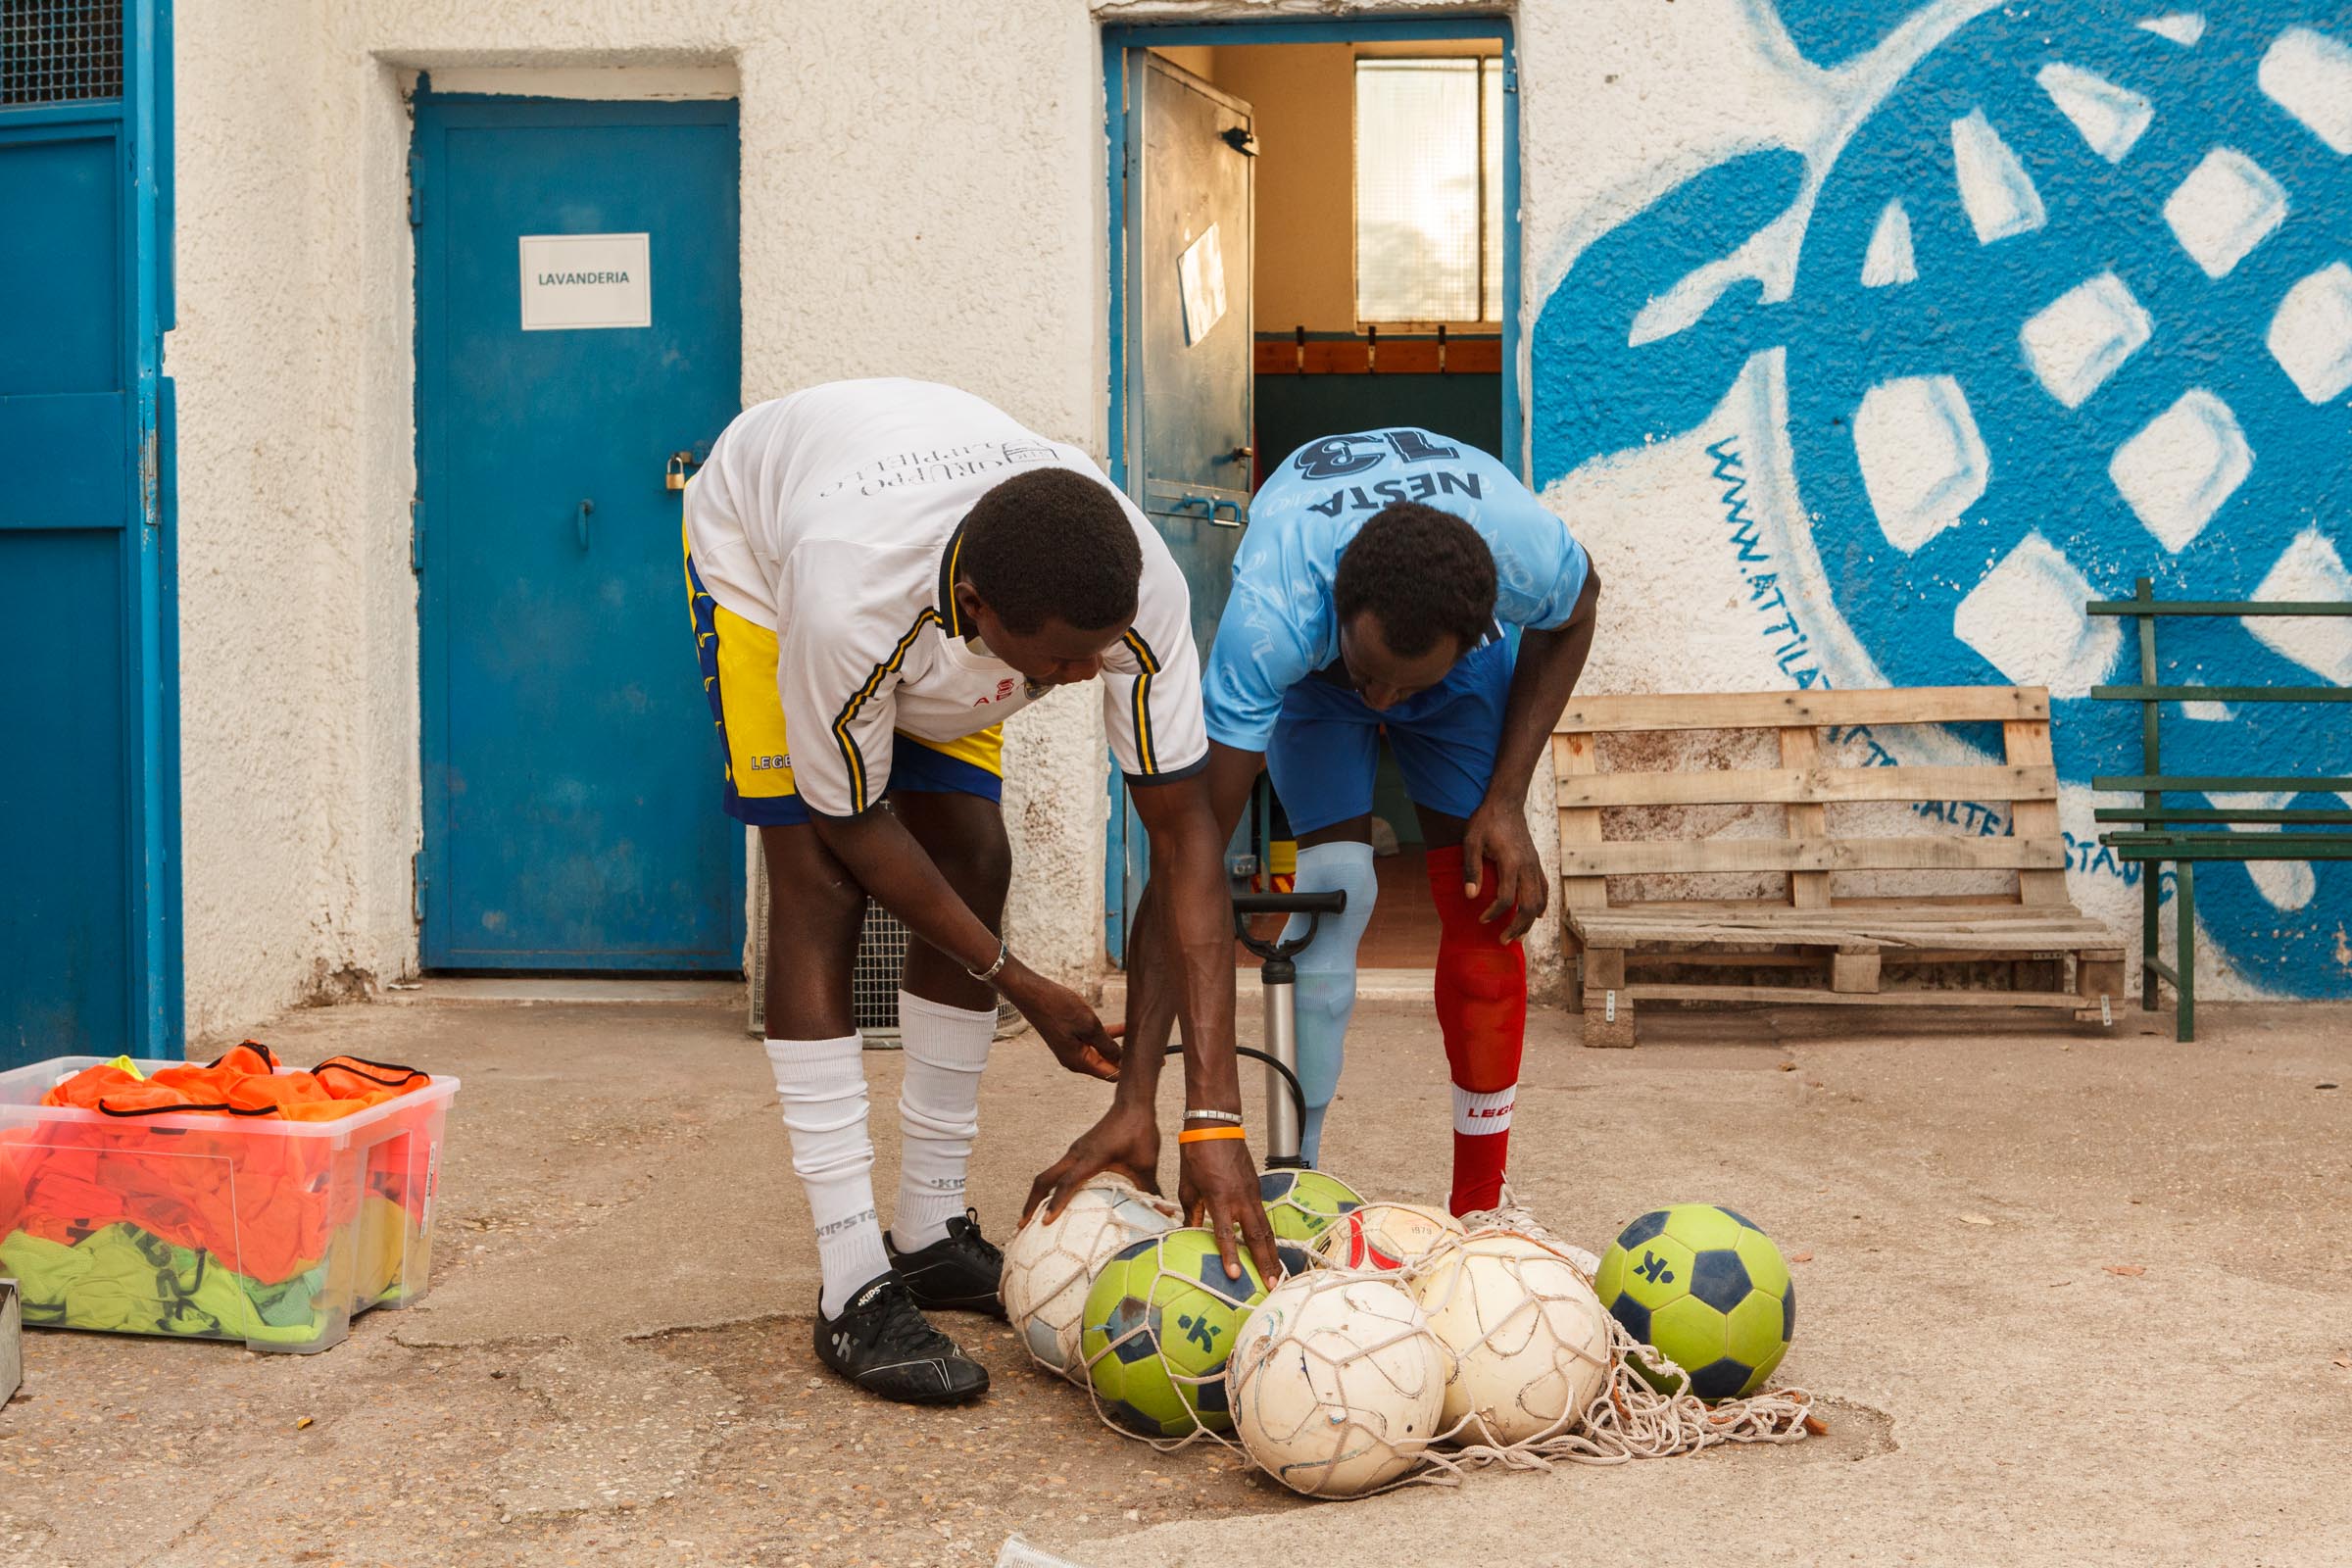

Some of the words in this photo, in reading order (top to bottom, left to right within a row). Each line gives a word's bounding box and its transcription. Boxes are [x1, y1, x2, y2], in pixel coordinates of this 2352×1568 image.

[538, 270, 630, 286] LAVANDERIA
[1293, 430, 1461, 481] 13
[1305, 470, 1483, 518] NESTA
